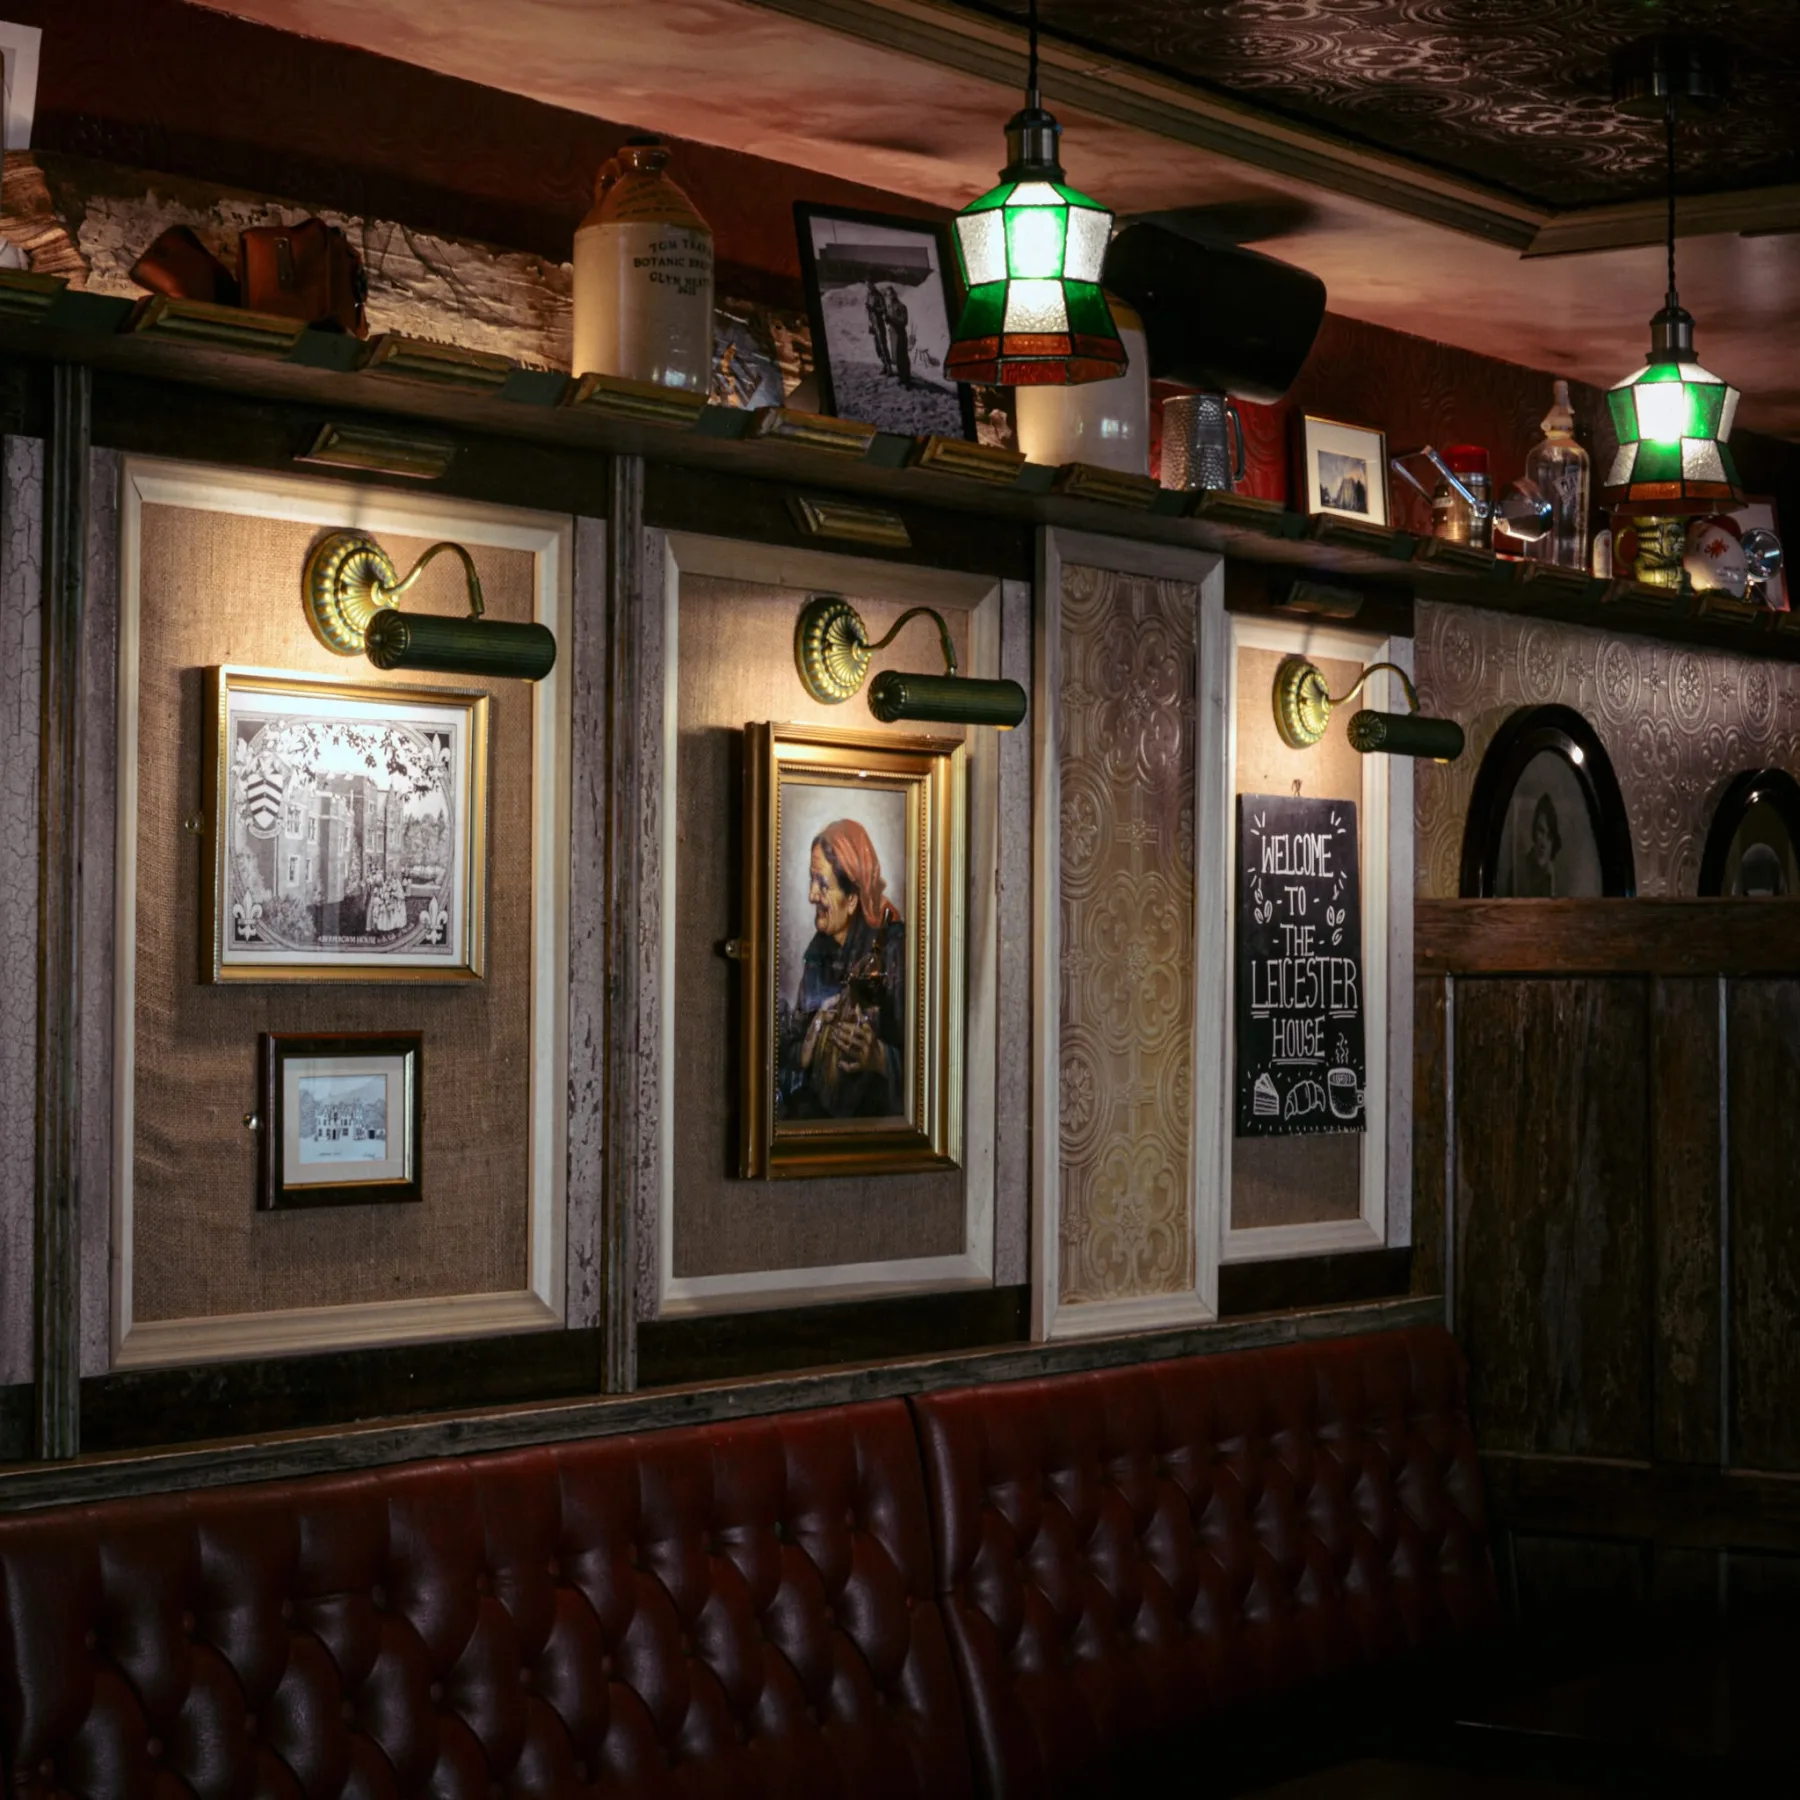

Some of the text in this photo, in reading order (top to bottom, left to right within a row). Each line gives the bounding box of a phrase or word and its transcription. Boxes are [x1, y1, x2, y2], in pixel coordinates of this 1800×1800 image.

[633, 257, 685, 268] BOTANIC
[649, 239, 677, 253] TOM
[1262, 833, 1334, 878] WELCOME
[1284, 886, 1306, 916] TO
[1280, 923, 1316, 956] THE
[1251, 956, 1358, 1009] LEICESTER
[1272, 1015, 1325, 1057] HOUSE
